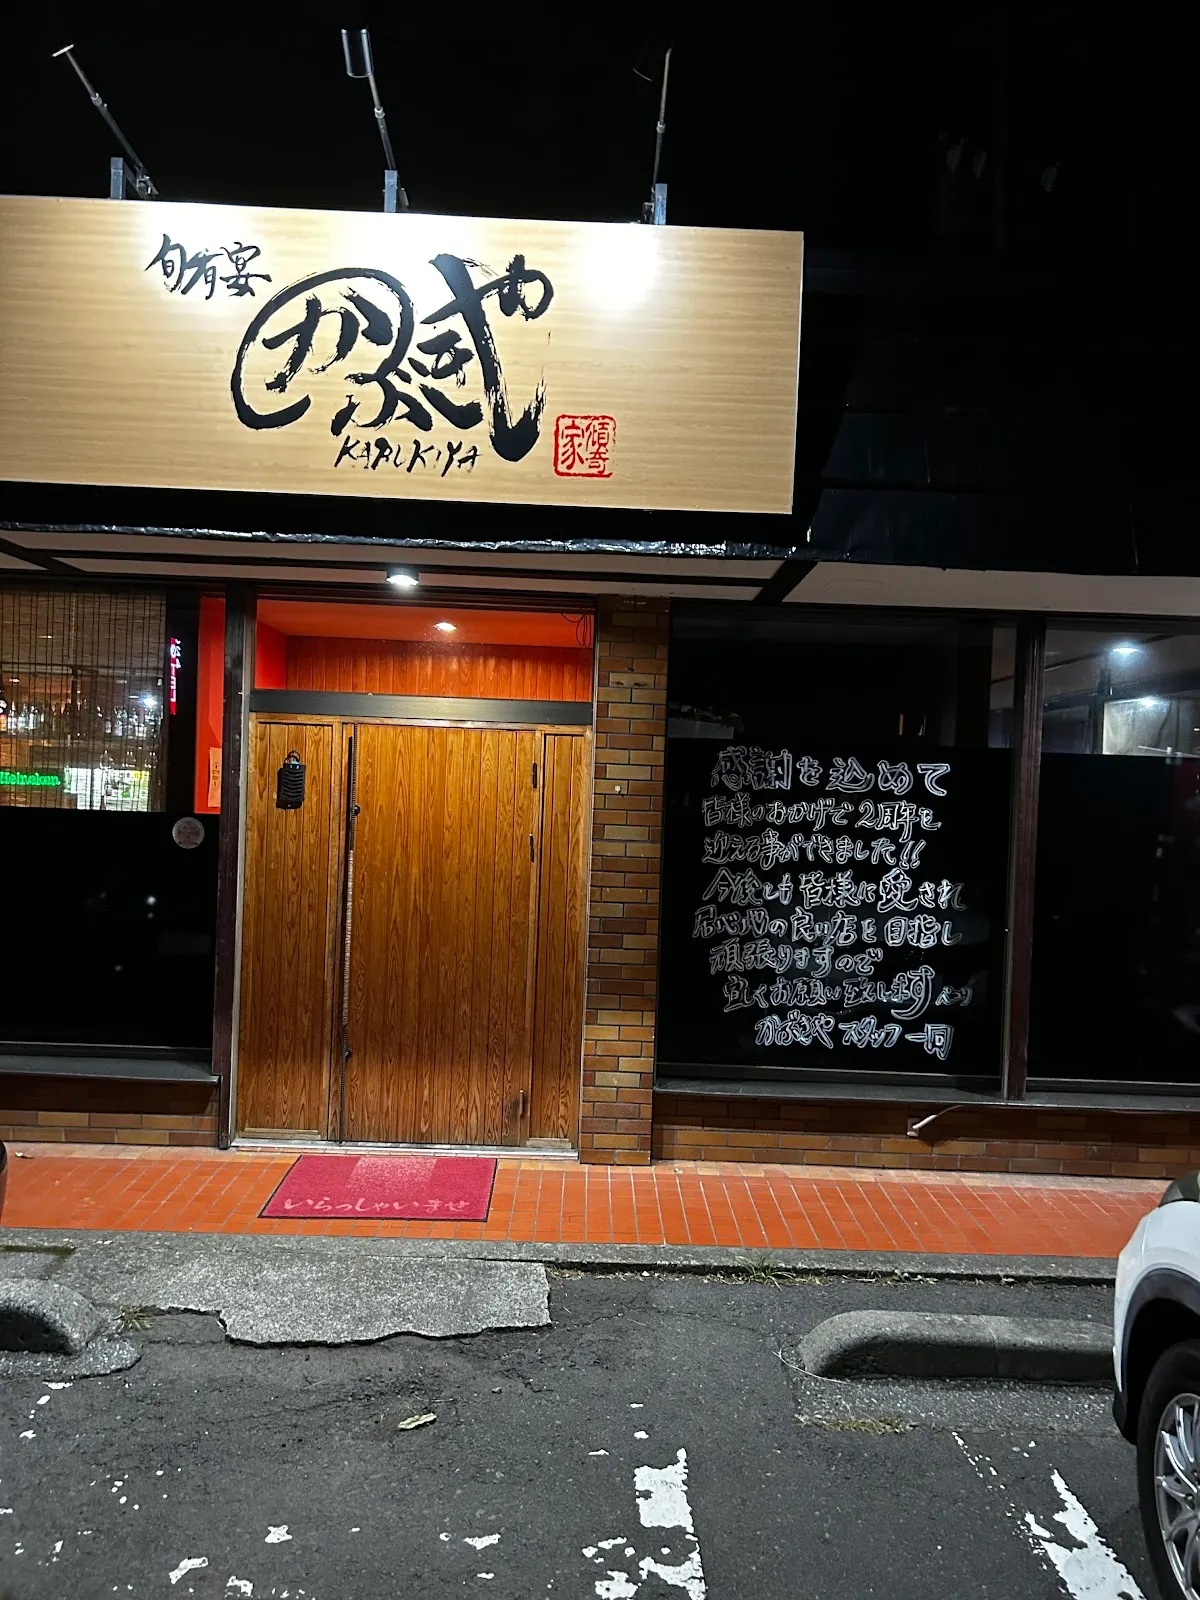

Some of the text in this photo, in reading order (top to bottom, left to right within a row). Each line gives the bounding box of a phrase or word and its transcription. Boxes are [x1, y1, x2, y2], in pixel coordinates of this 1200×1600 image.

[710, 746, 951, 797] 感謝を込めて
[709, 937, 884, 978] 頑張りますので
[283, 1196, 471, 1213] いらっしゃいませ
